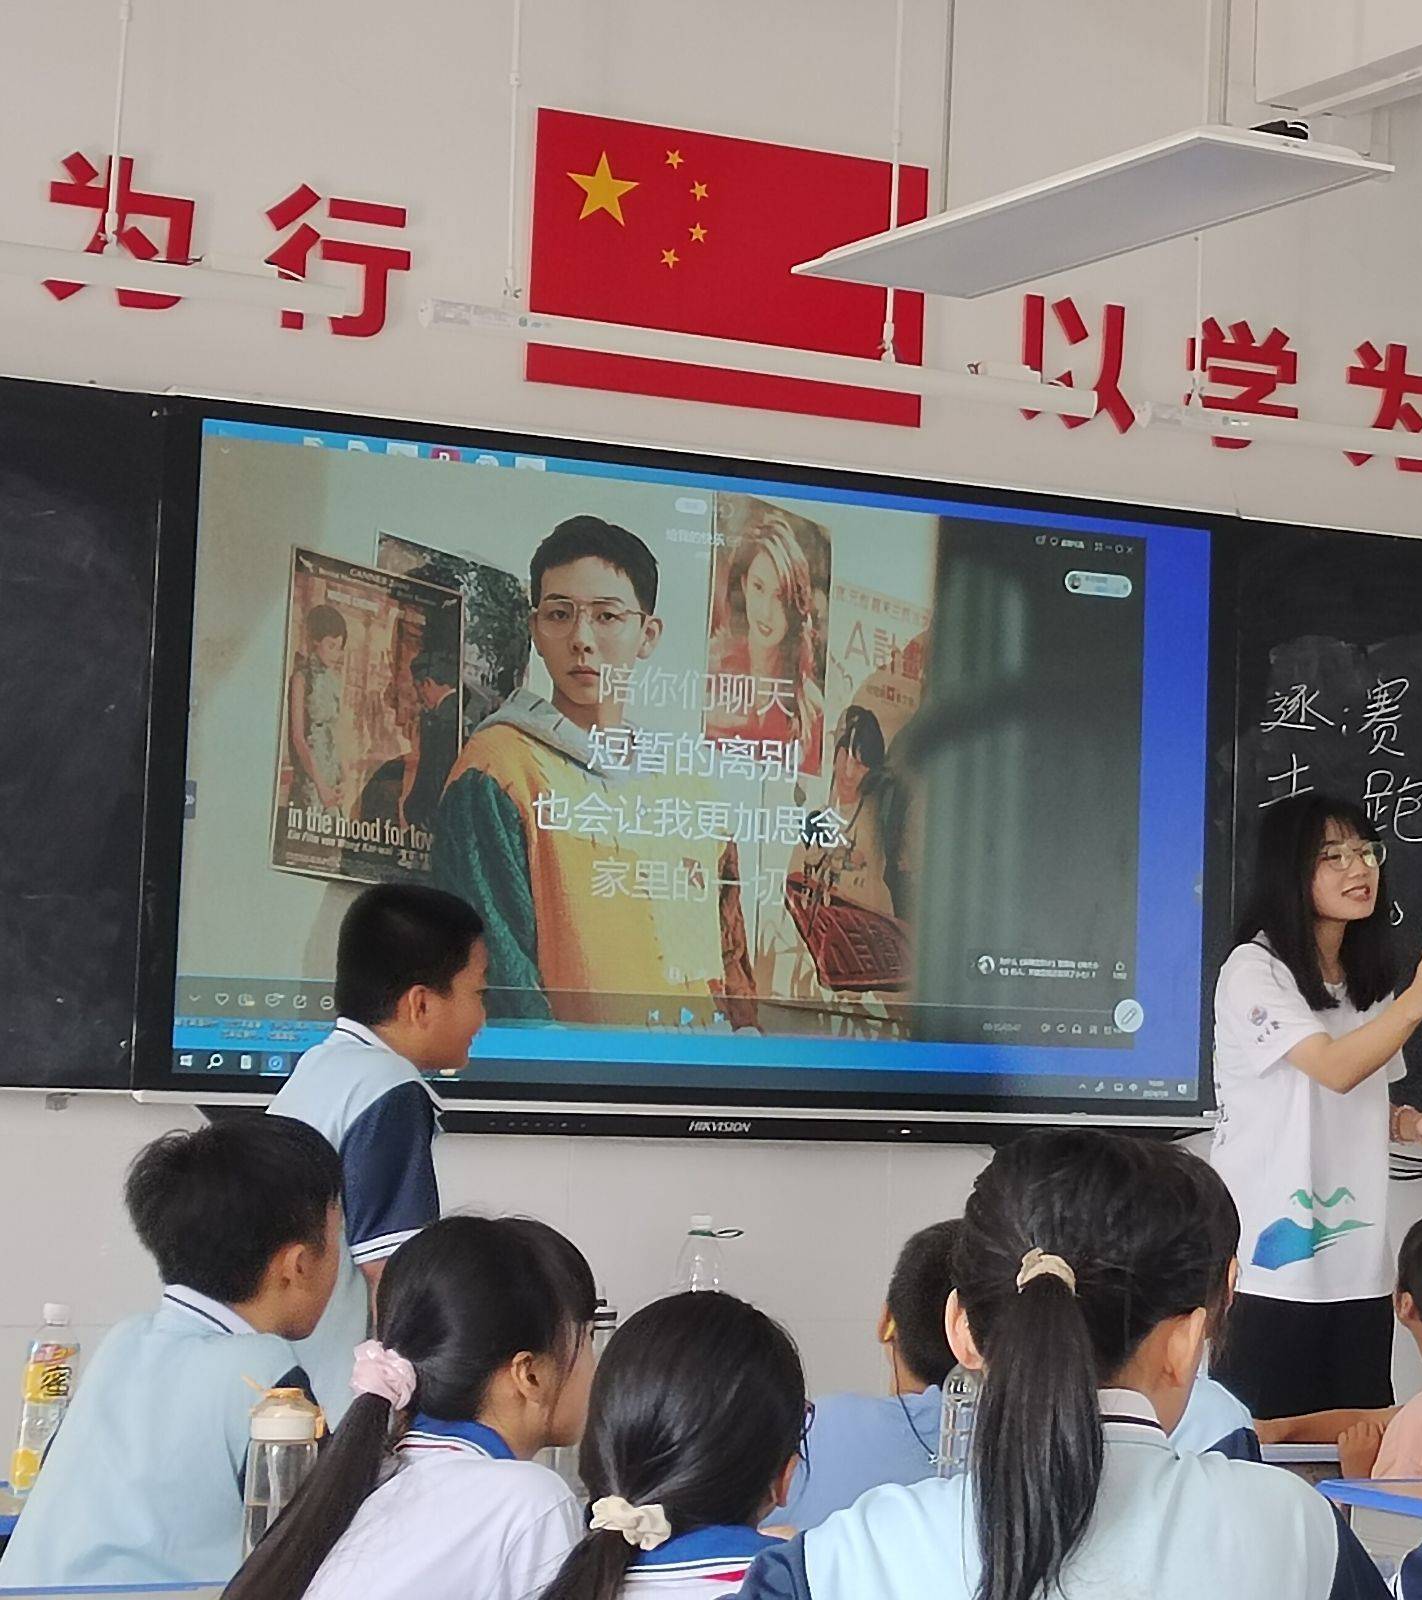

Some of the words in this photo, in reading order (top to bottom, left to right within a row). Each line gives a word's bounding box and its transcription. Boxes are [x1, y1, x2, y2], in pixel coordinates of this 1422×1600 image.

[598, 662, 796, 718] 陪你们聊天
[586, 723, 802, 784] 短暂的离别
[306, 804, 332, 835] the
[532, 790, 850, 848] 也会让我更加思念
[590, 856, 787, 907] 家里的一切
[688, 1120, 751, 1133] HIKVISION
